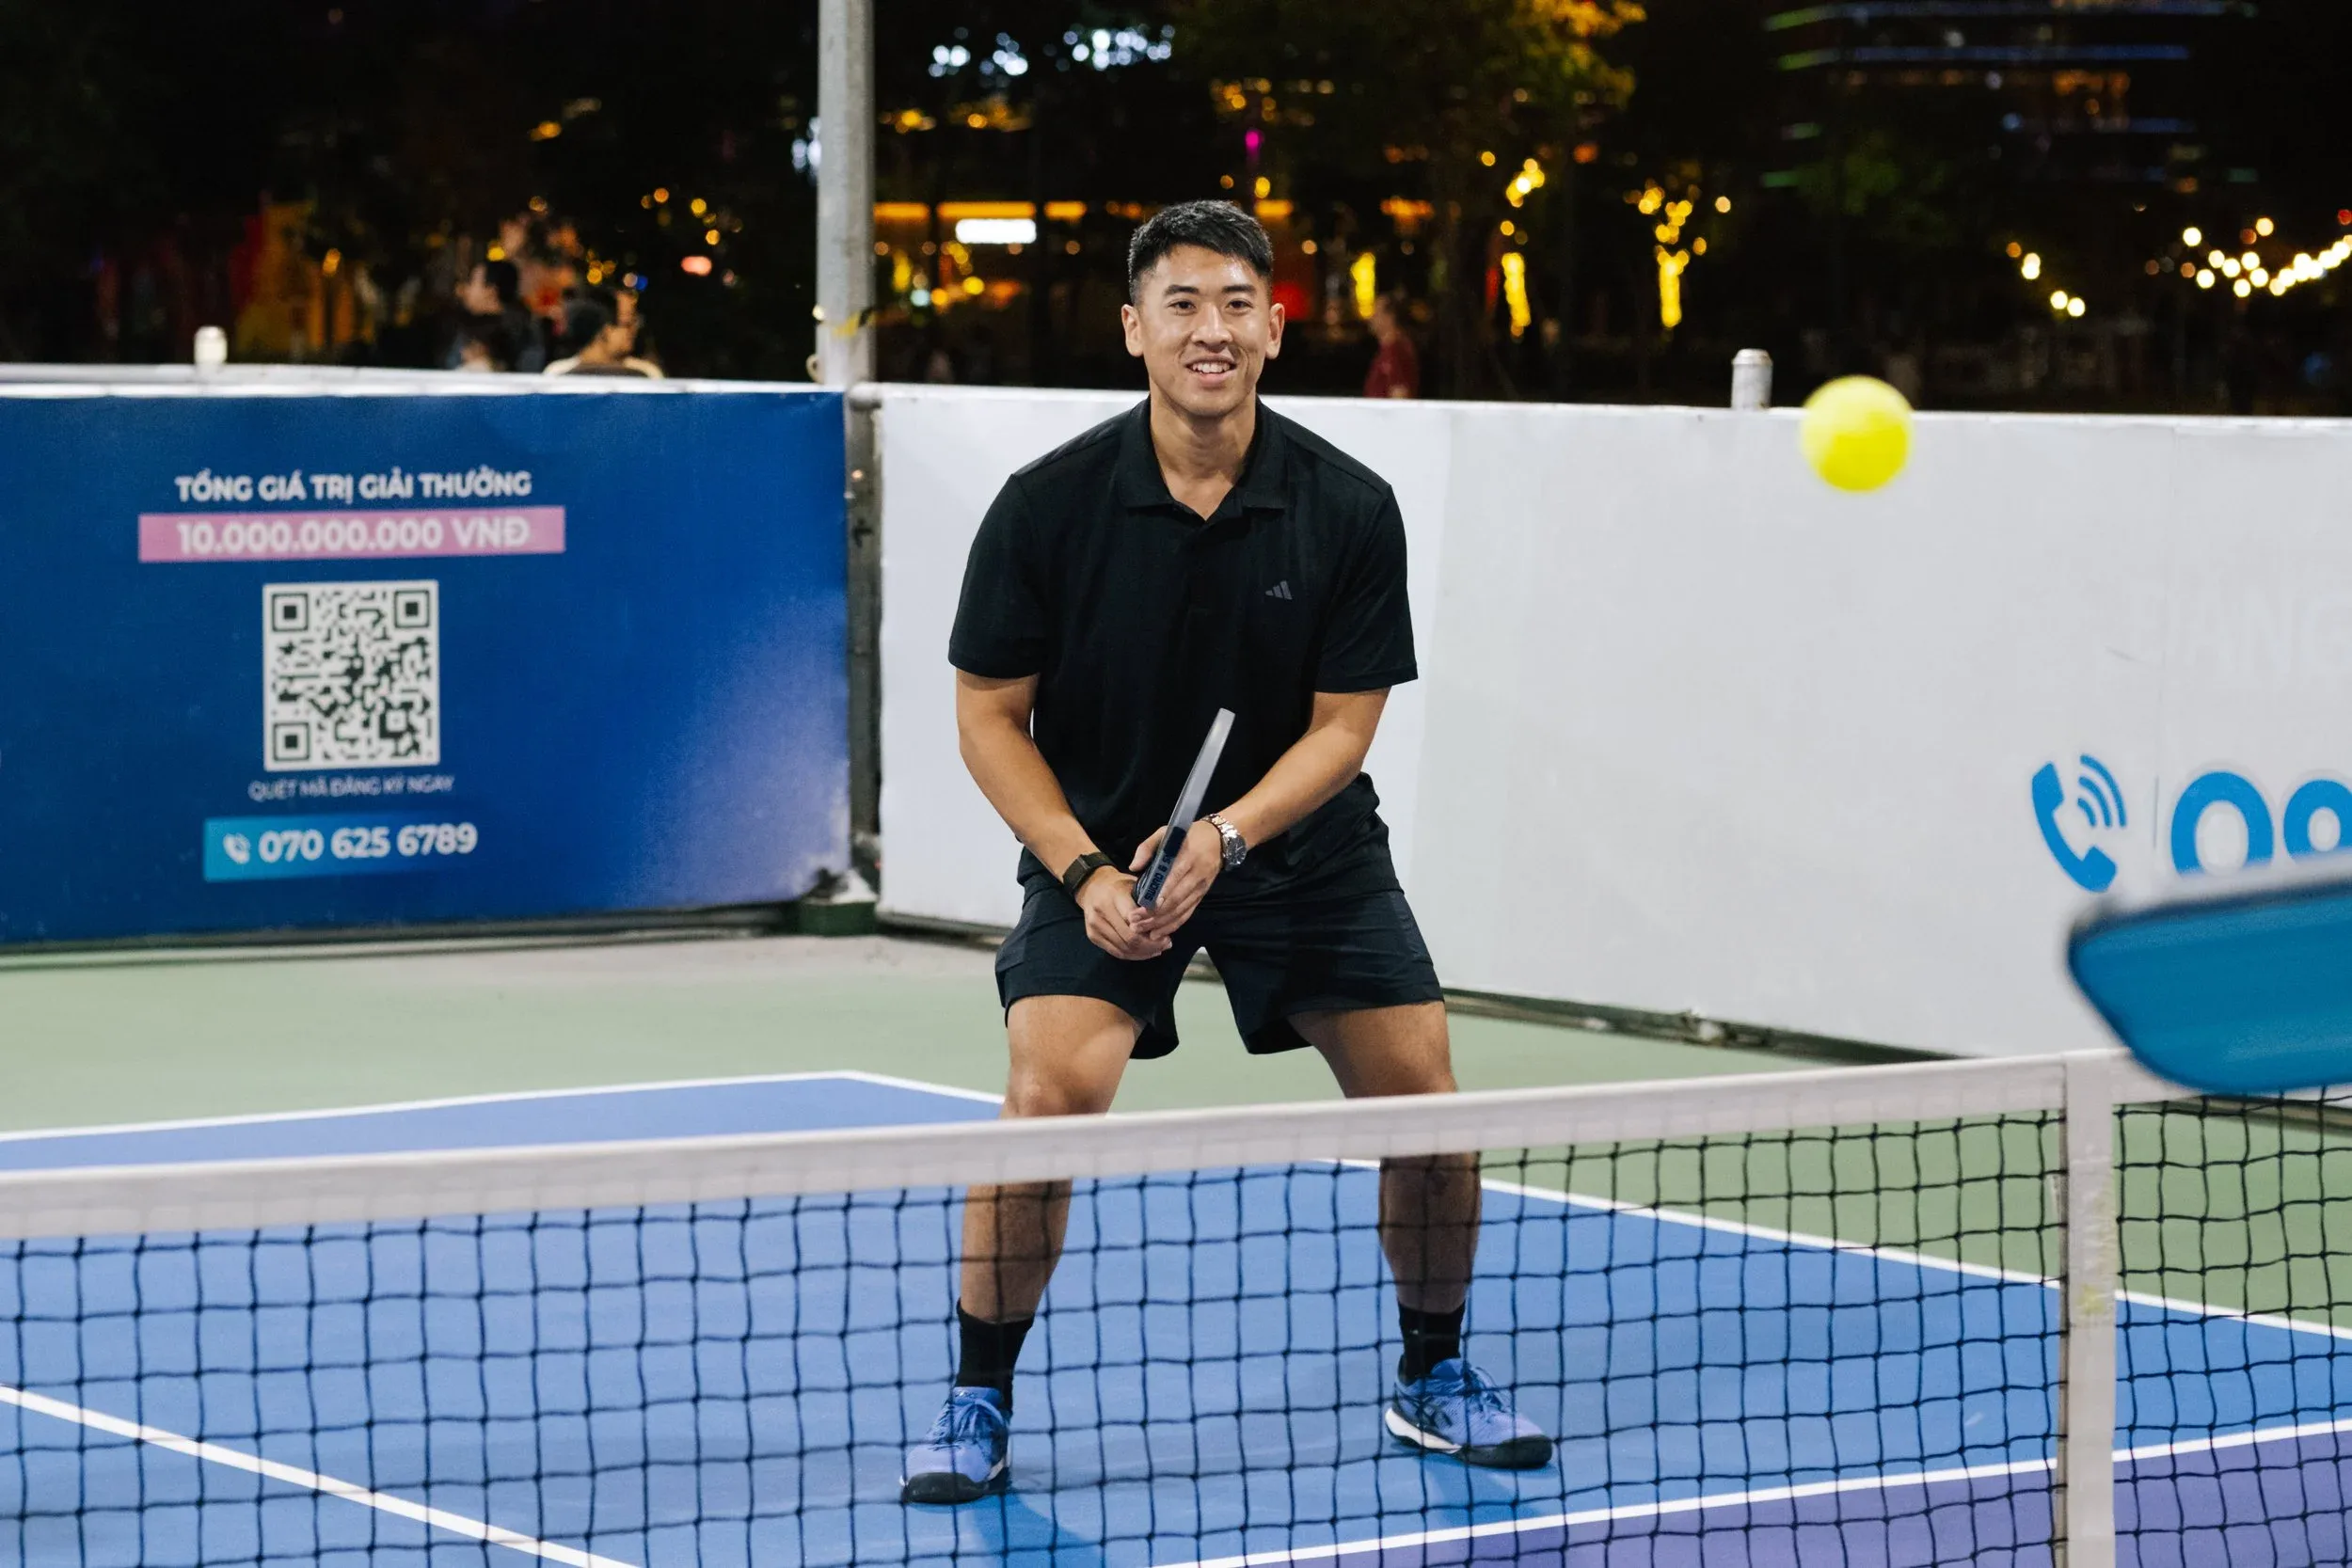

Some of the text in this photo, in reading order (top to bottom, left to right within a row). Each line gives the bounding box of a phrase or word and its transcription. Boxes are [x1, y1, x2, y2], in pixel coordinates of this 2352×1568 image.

[175, 465, 532, 504] TỔNG GIÁ TRỊ GIẢI THƯỞNG
[176, 516, 530, 554] 10.000.000.000 VNĐ
[259, 822, 478, 863] 070 625 6789
